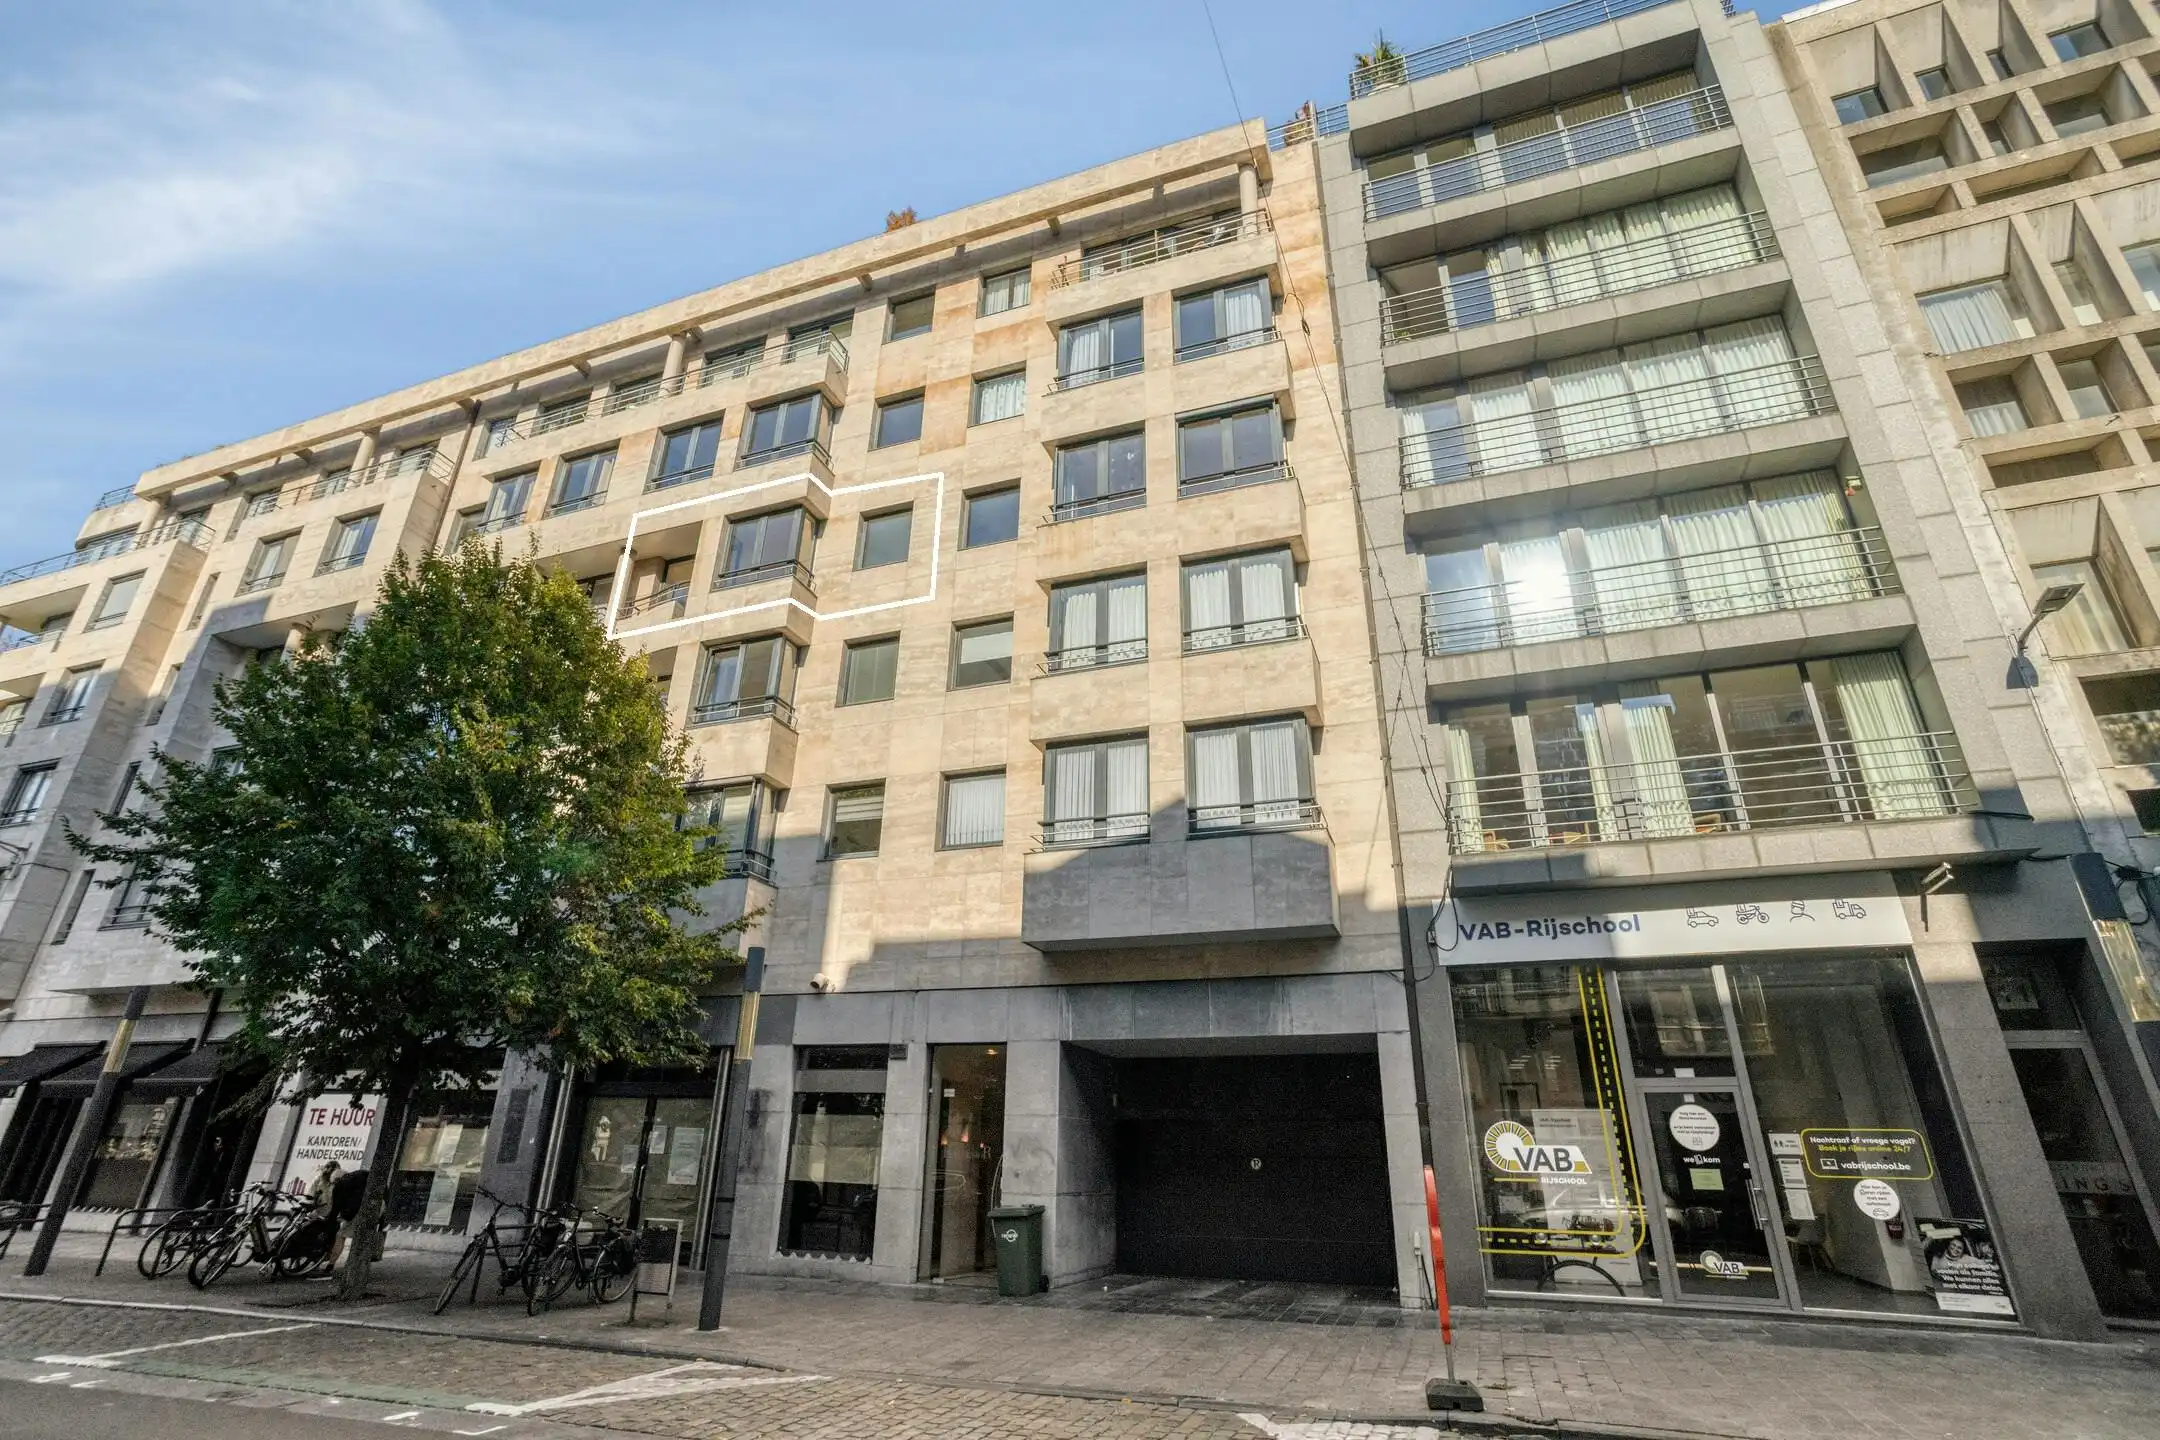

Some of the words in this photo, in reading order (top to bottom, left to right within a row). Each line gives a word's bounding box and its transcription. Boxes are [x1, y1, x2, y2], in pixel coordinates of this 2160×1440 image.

[1460, 914, 1640, 940] VAB-Rijschool
[309, 1108, 327, 1126] TE
[330, 1108, 376, 1126] HUUR
[1851, 1136, 1860, 1144] of
[1513, 1147, 1573, 1172] VAB
[1841, 1161, 1911, 1170] vabrijschool.be
[1541, 1177, 1587, 1185] RIJSCHOOL
[1713, 1262, 1740, 1273] VAB
